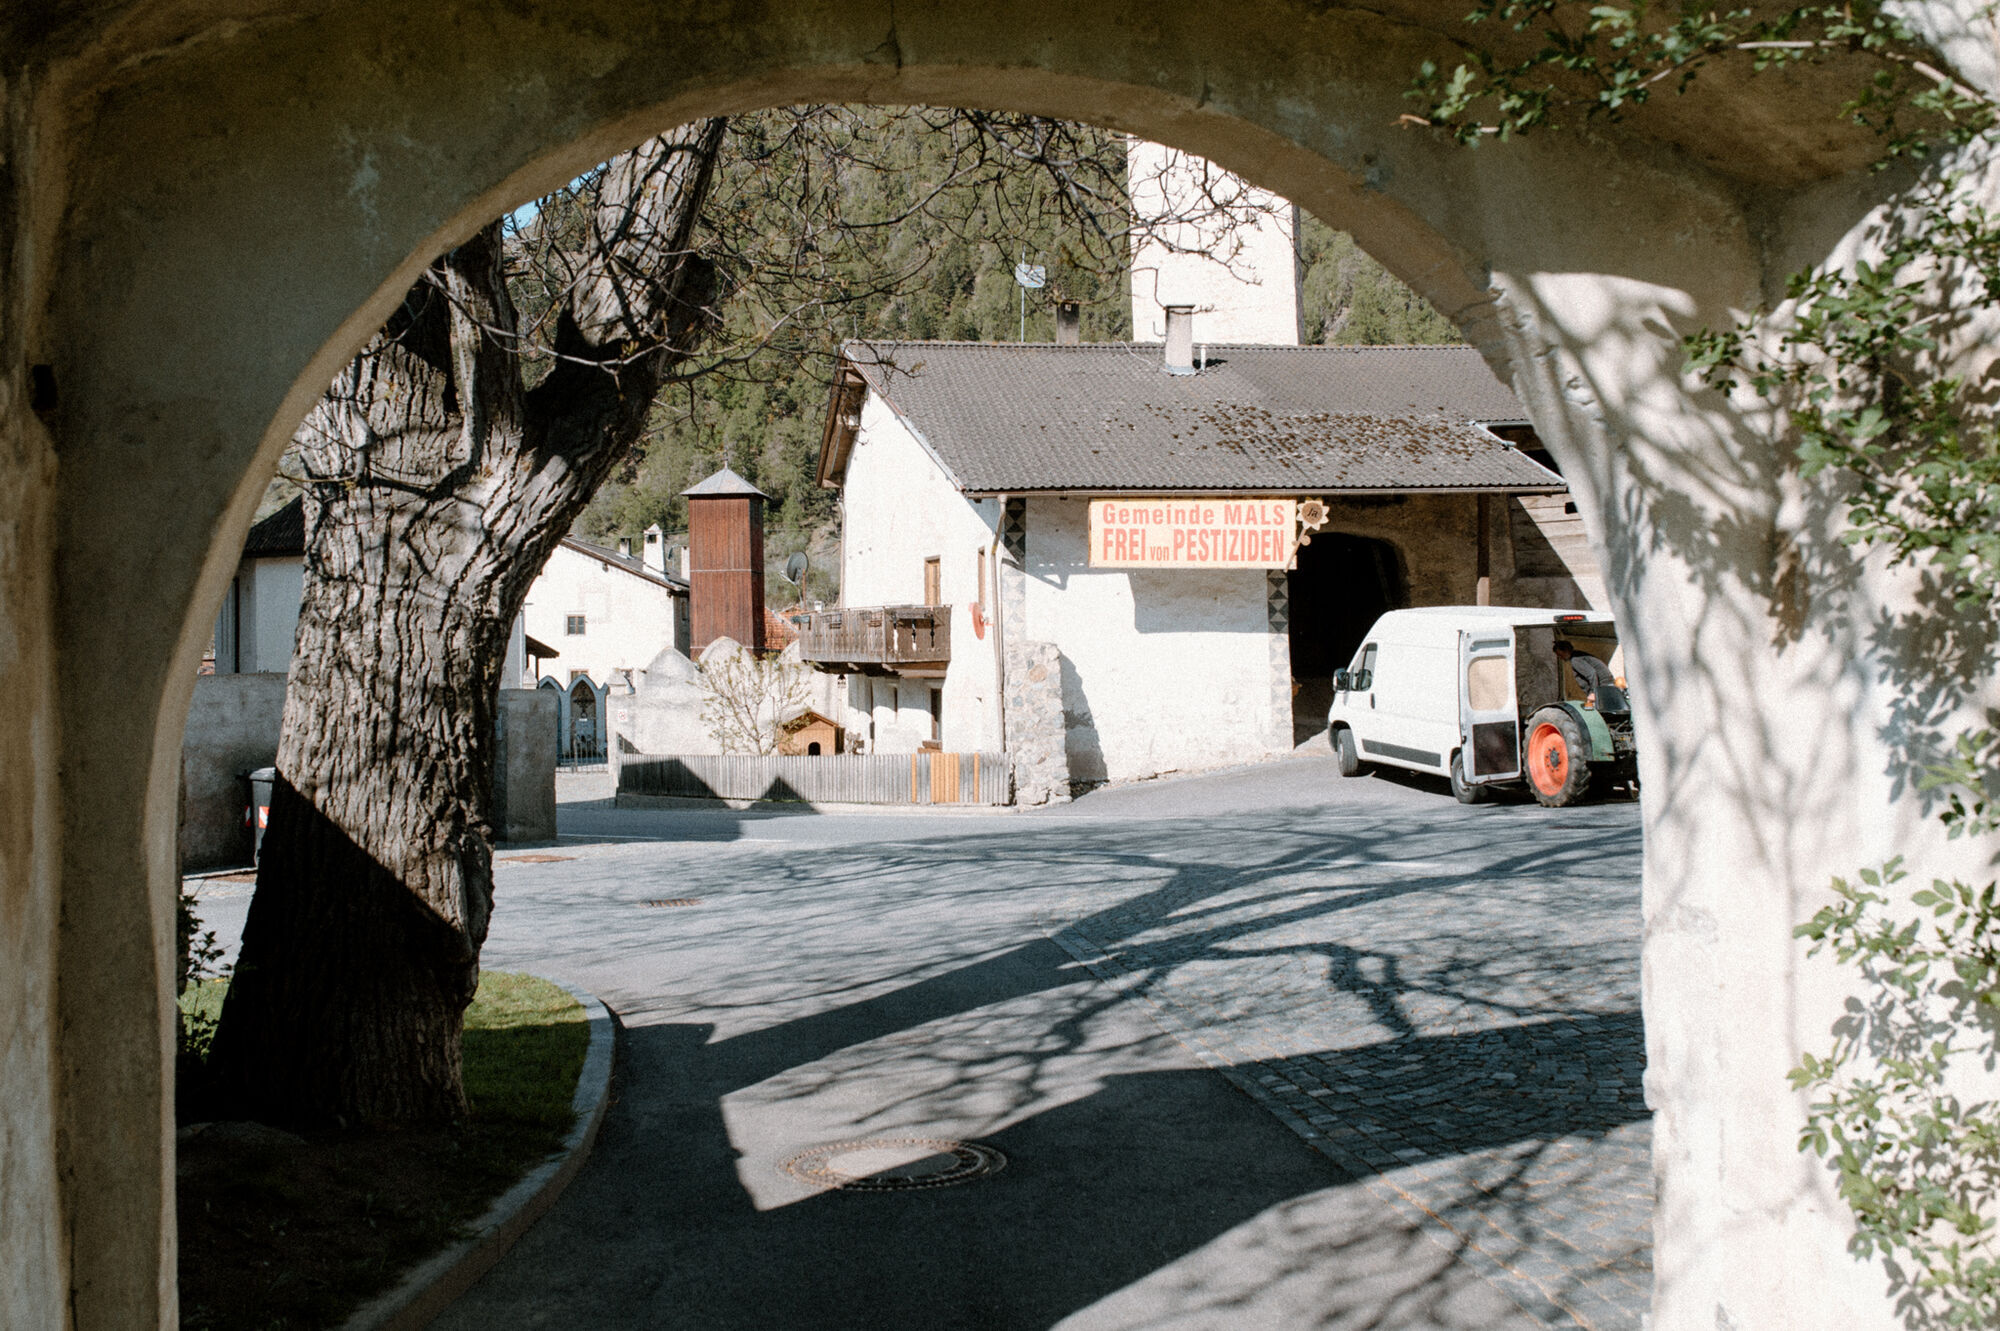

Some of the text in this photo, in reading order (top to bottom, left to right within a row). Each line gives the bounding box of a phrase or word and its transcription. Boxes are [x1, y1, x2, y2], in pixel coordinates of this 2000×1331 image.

[1103, 503, 1285, 525] Gemeinde MALS
[1103, 529, 1284, 562] FREI von PESTIZIDEN
